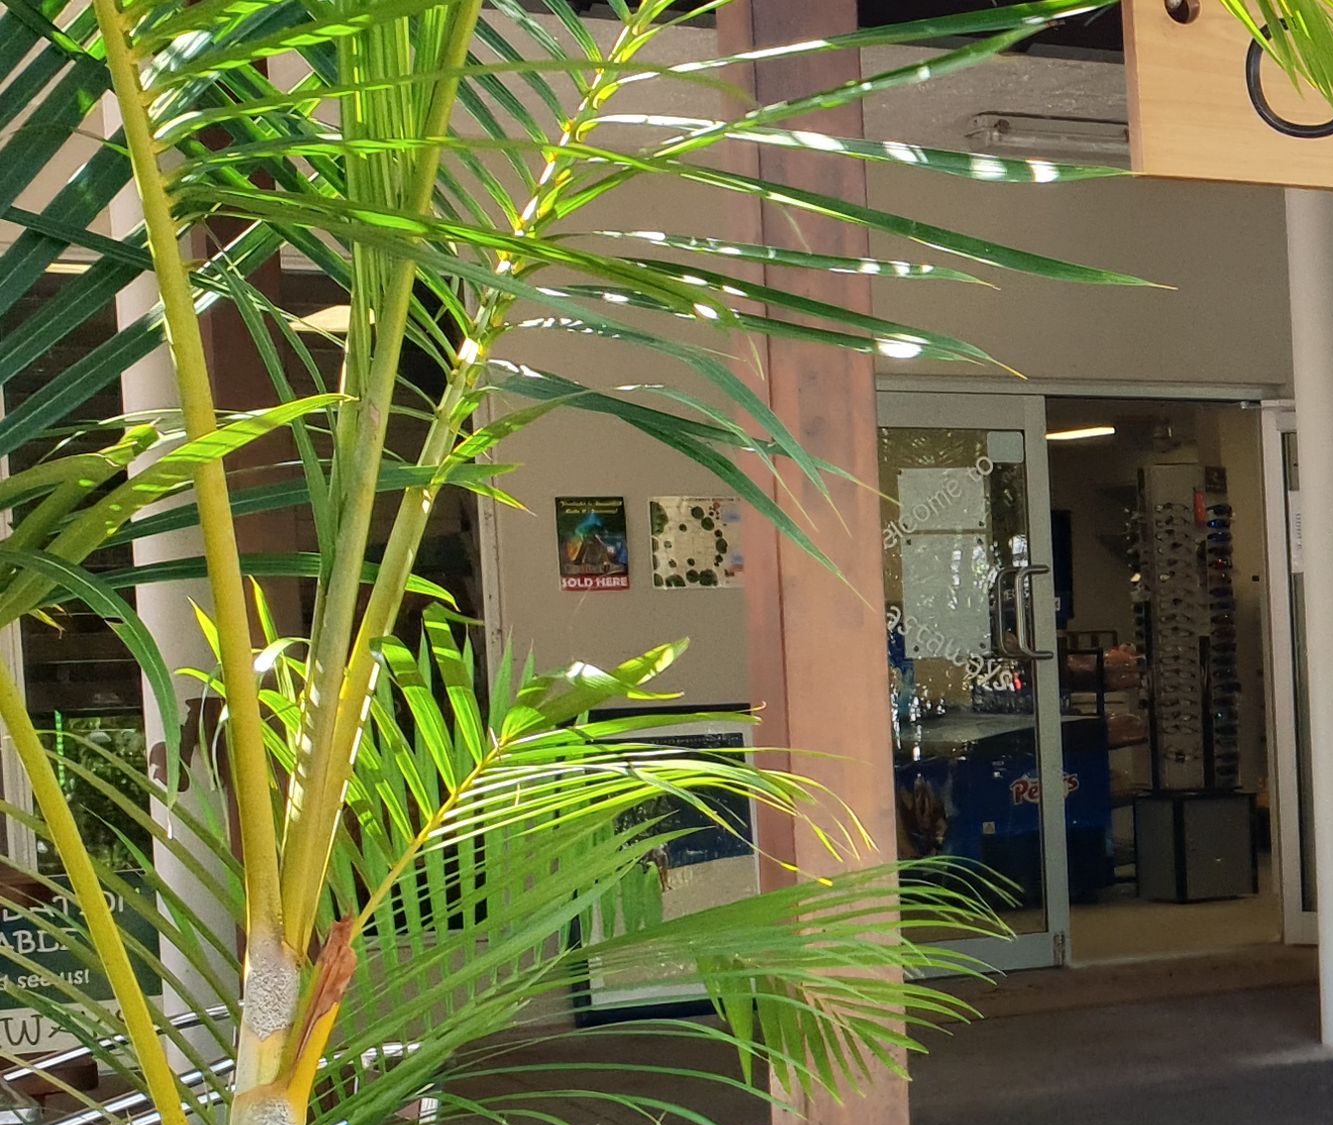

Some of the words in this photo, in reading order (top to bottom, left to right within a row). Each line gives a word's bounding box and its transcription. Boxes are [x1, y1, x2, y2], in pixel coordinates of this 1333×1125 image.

[883, 478, 962, 550] elcome
[967, 456, 993, 482] to
[562, 577, 593, 588] SOLD
[596, 576, 628, 587] HERE
[886, 605, 1014, 691] astaways
